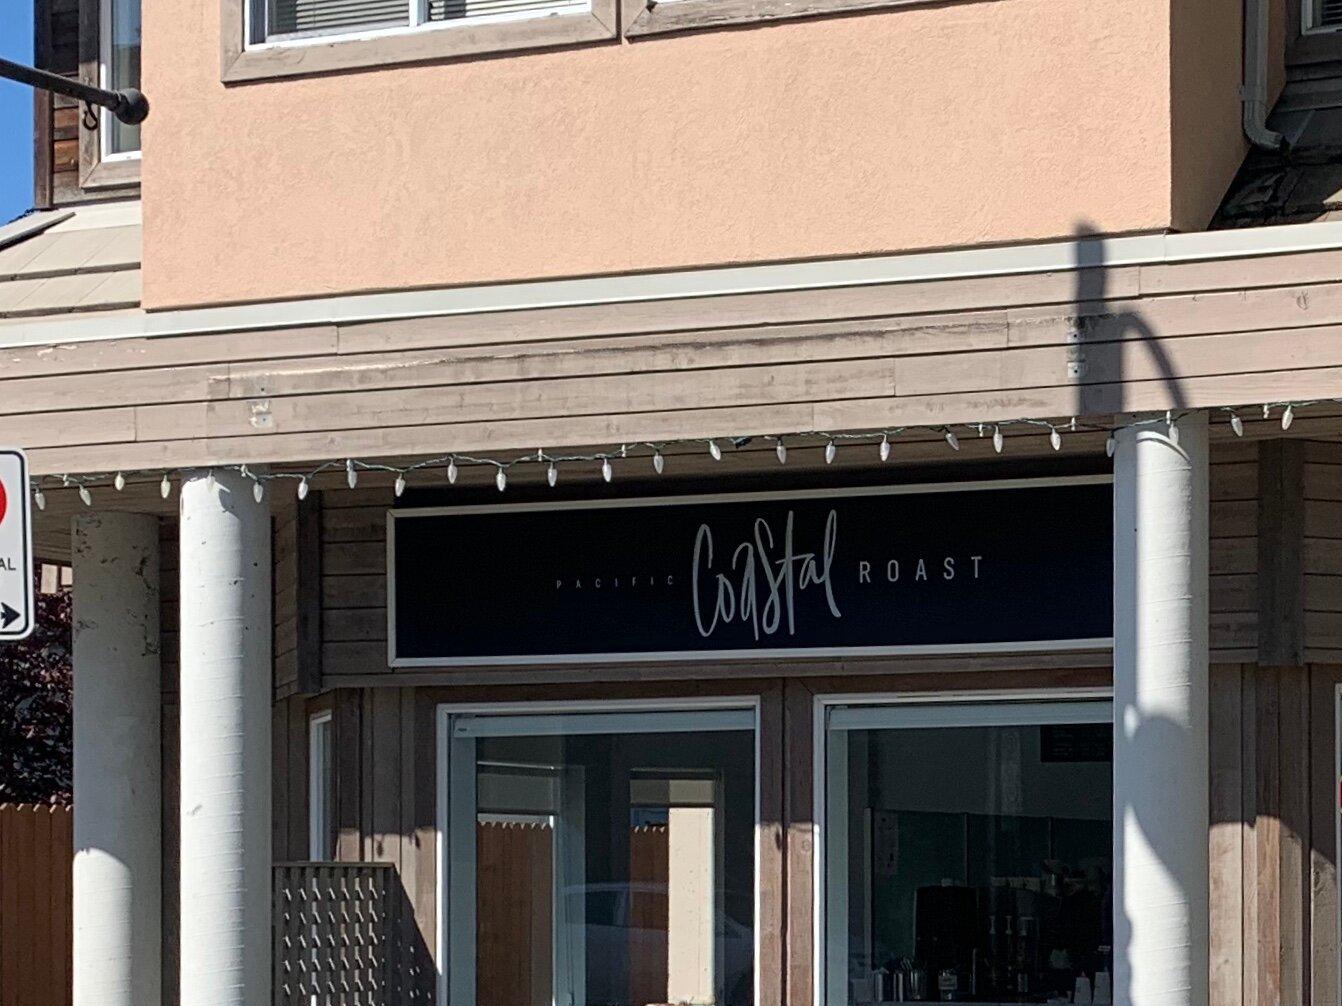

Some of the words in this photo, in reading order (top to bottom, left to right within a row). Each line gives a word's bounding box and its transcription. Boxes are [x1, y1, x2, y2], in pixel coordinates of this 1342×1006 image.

[556, 575, 675, 589] PACIFIC
[691, 509, 842, 641] Coastal
[859, 556, 984, 583] ROAST
